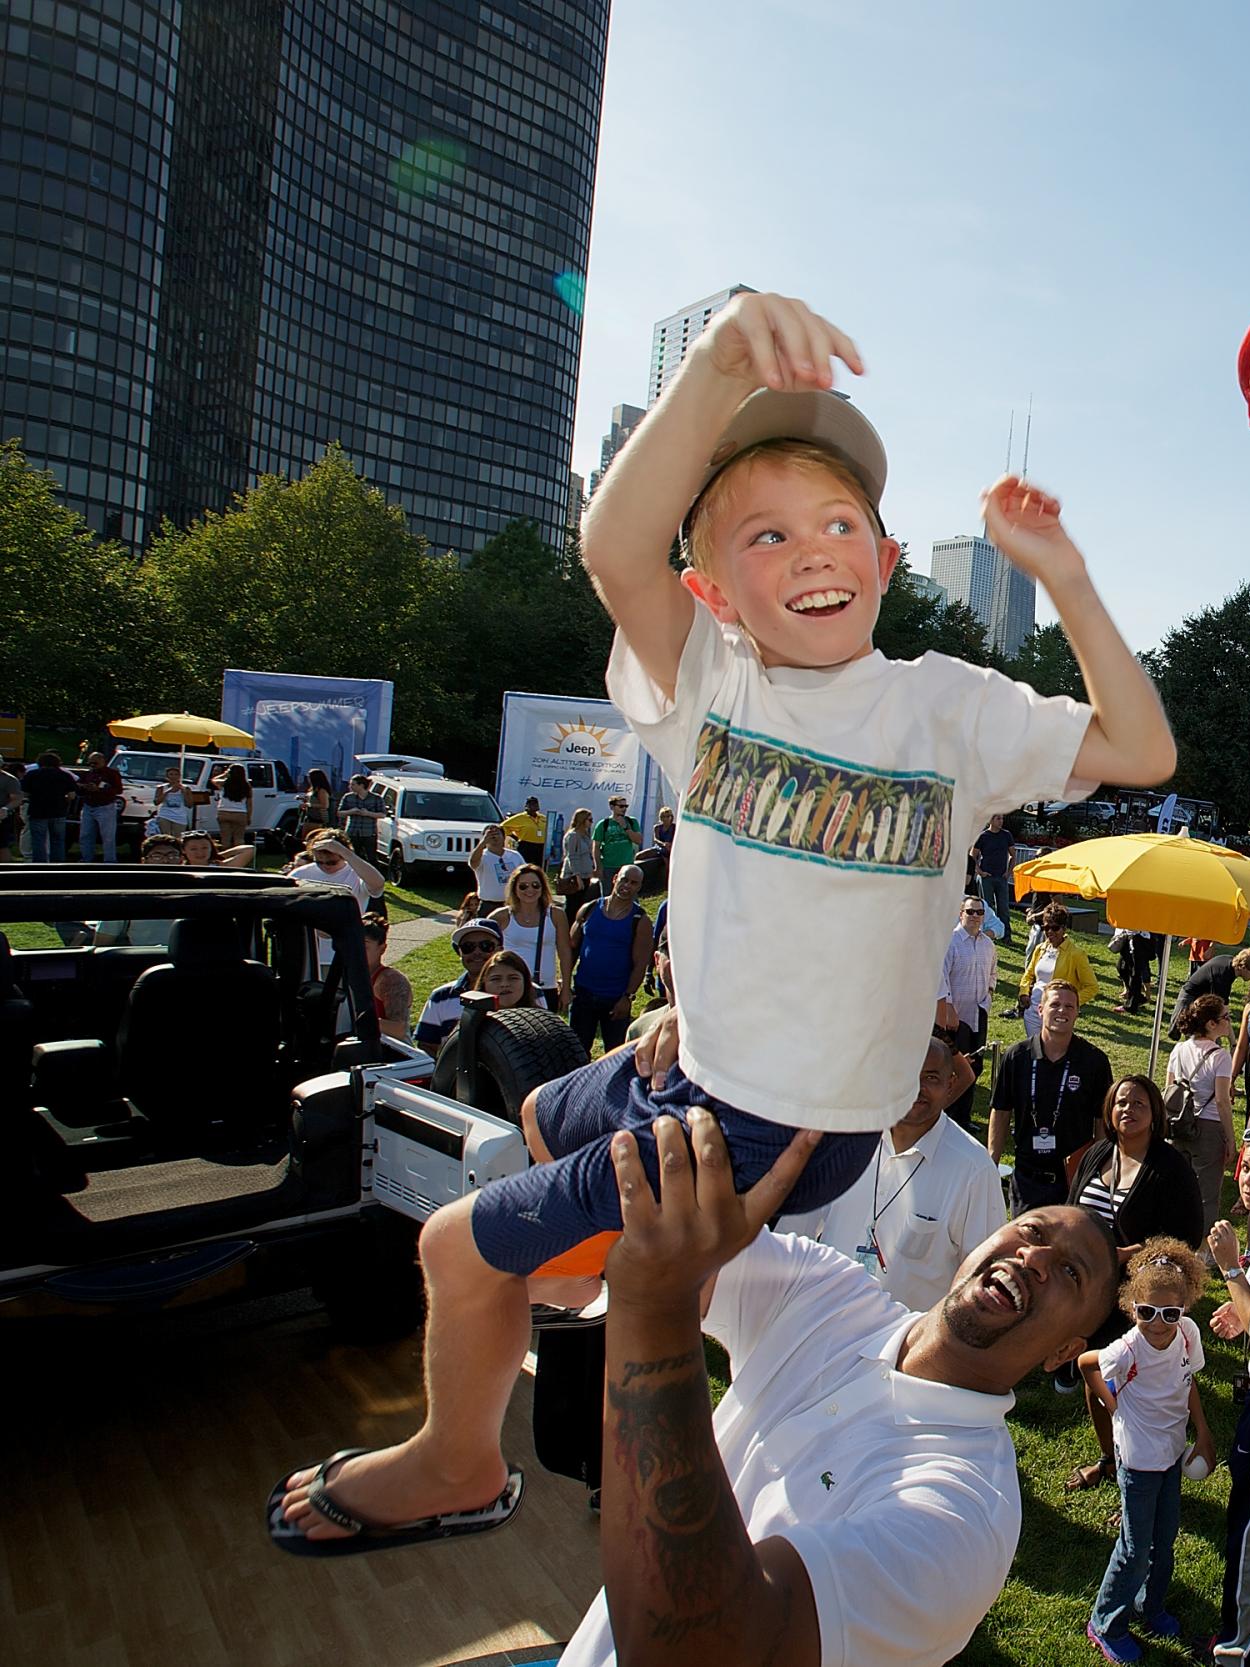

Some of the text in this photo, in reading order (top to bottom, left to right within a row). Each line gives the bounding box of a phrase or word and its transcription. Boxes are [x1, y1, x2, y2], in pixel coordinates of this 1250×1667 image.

[241, 696, 365, 716] #JEEPSUMMER
[566, 743, 595, 756] Jeep
[519, 776, 633, 795] #JEEPSUMMER
